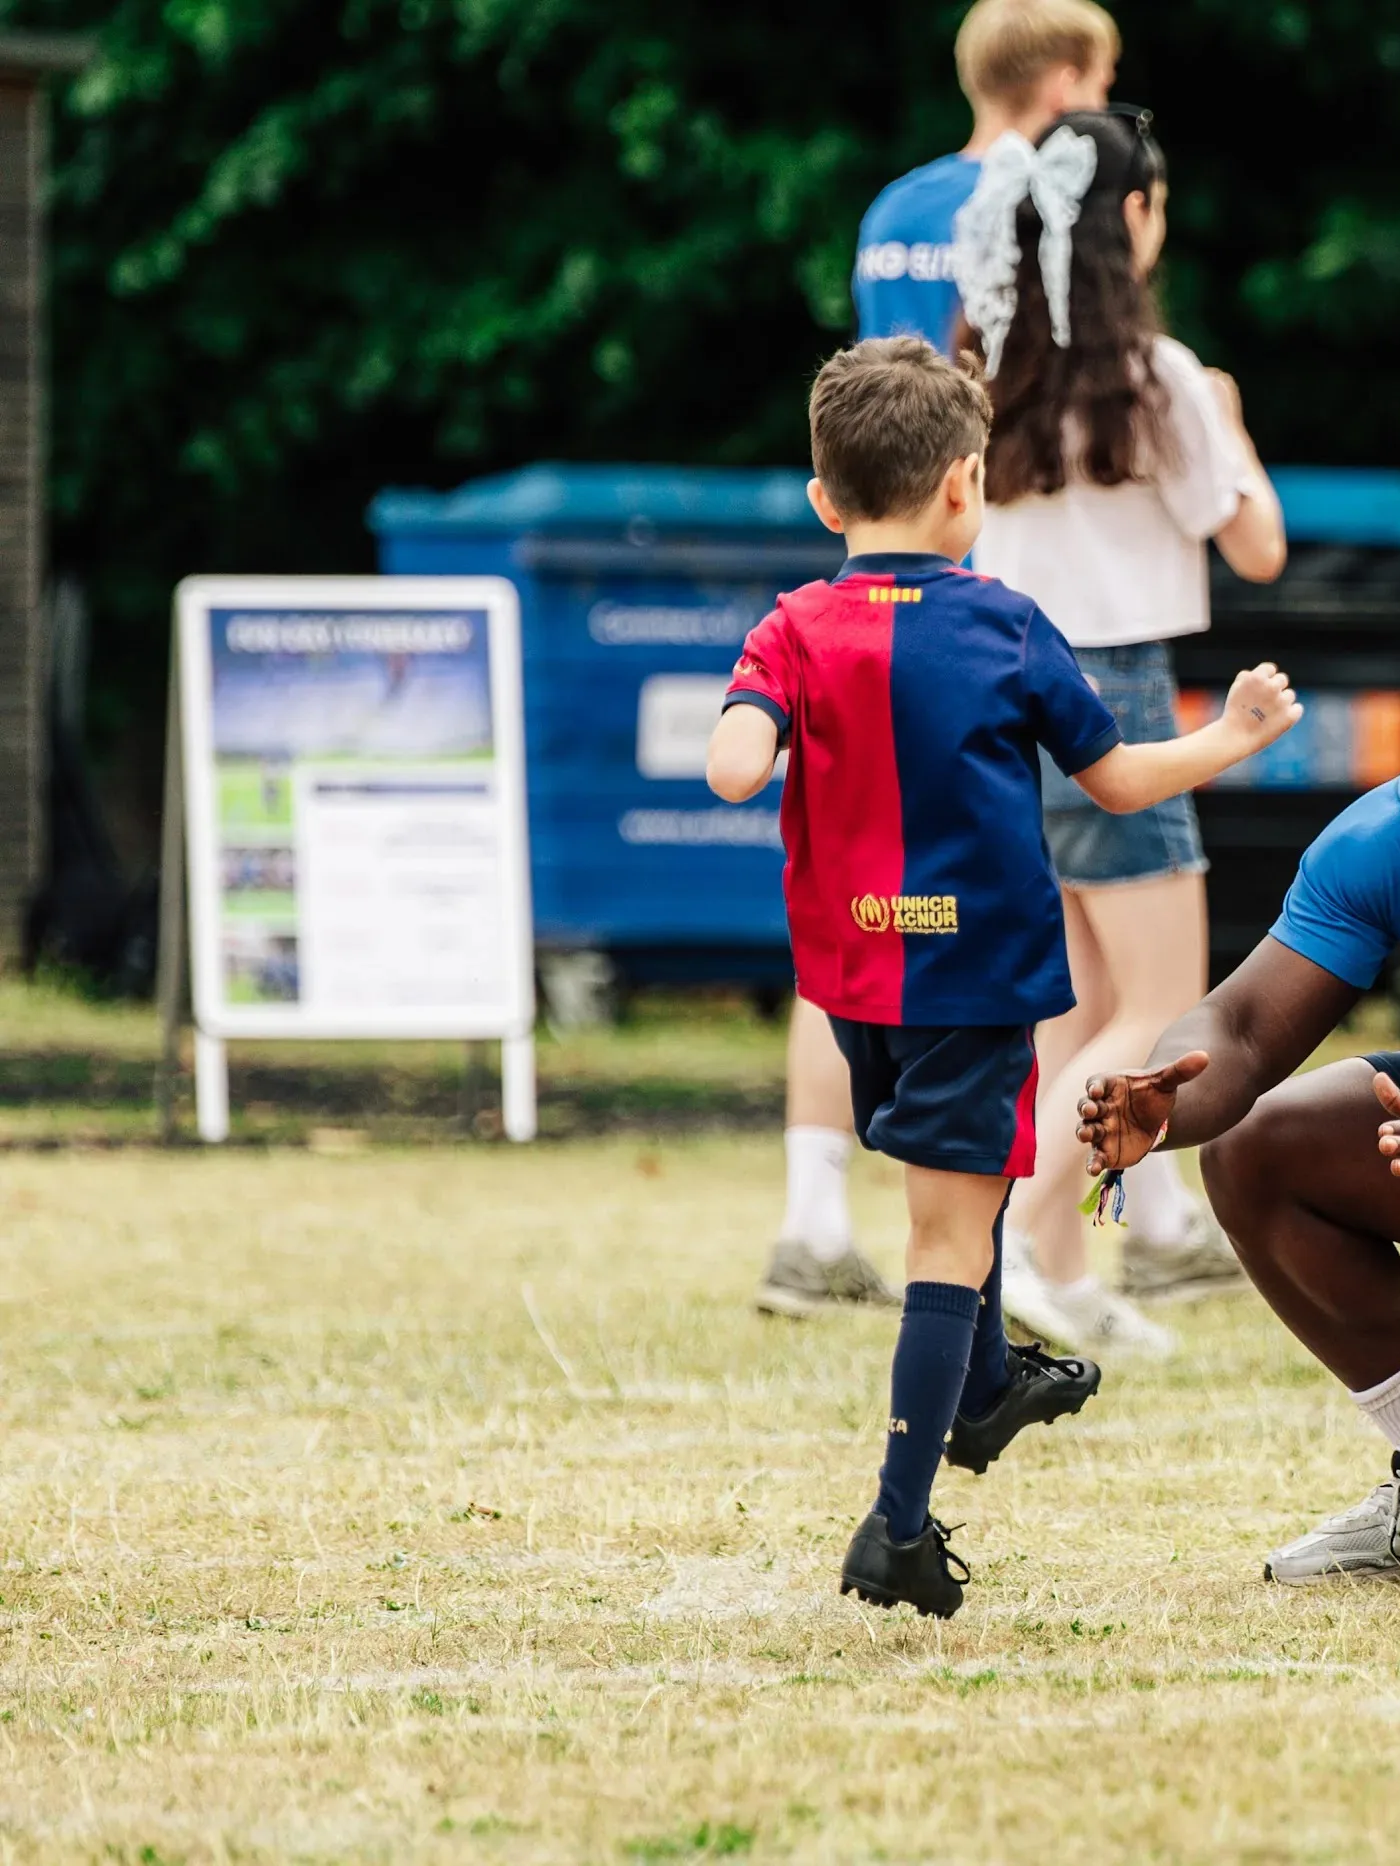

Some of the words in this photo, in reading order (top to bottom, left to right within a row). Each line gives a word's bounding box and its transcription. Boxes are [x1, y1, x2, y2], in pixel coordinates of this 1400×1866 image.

[858, 241, 907, 281] NG
[890, 896, 957, 912] UNHCR
[893, 911, 958, 928] ACNUR
[915, 927, 936, 935] Refugee
[936, 927, 959, 935] Agency
